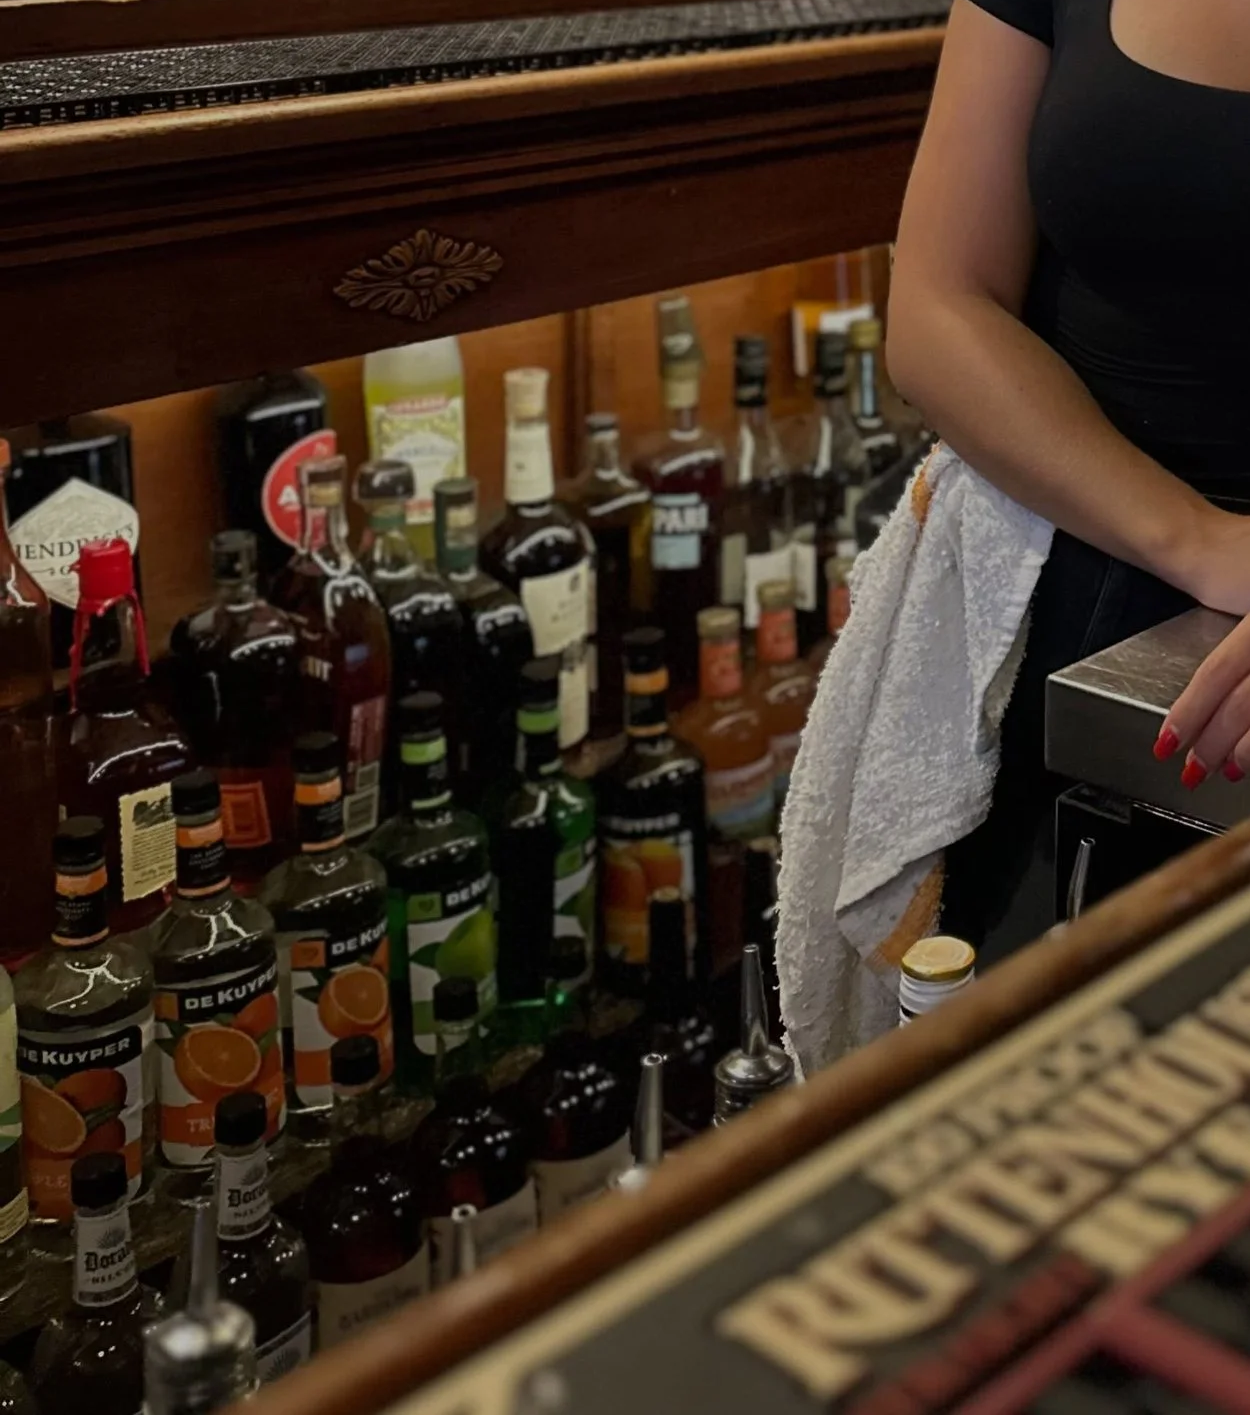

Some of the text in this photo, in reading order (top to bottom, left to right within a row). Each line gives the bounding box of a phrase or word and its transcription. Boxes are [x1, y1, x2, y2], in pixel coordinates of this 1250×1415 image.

[331, 936, 359, 956] DE
[185, 994, 215, 1011] DE
[42, 1036, 131, 1067] KUYPER
